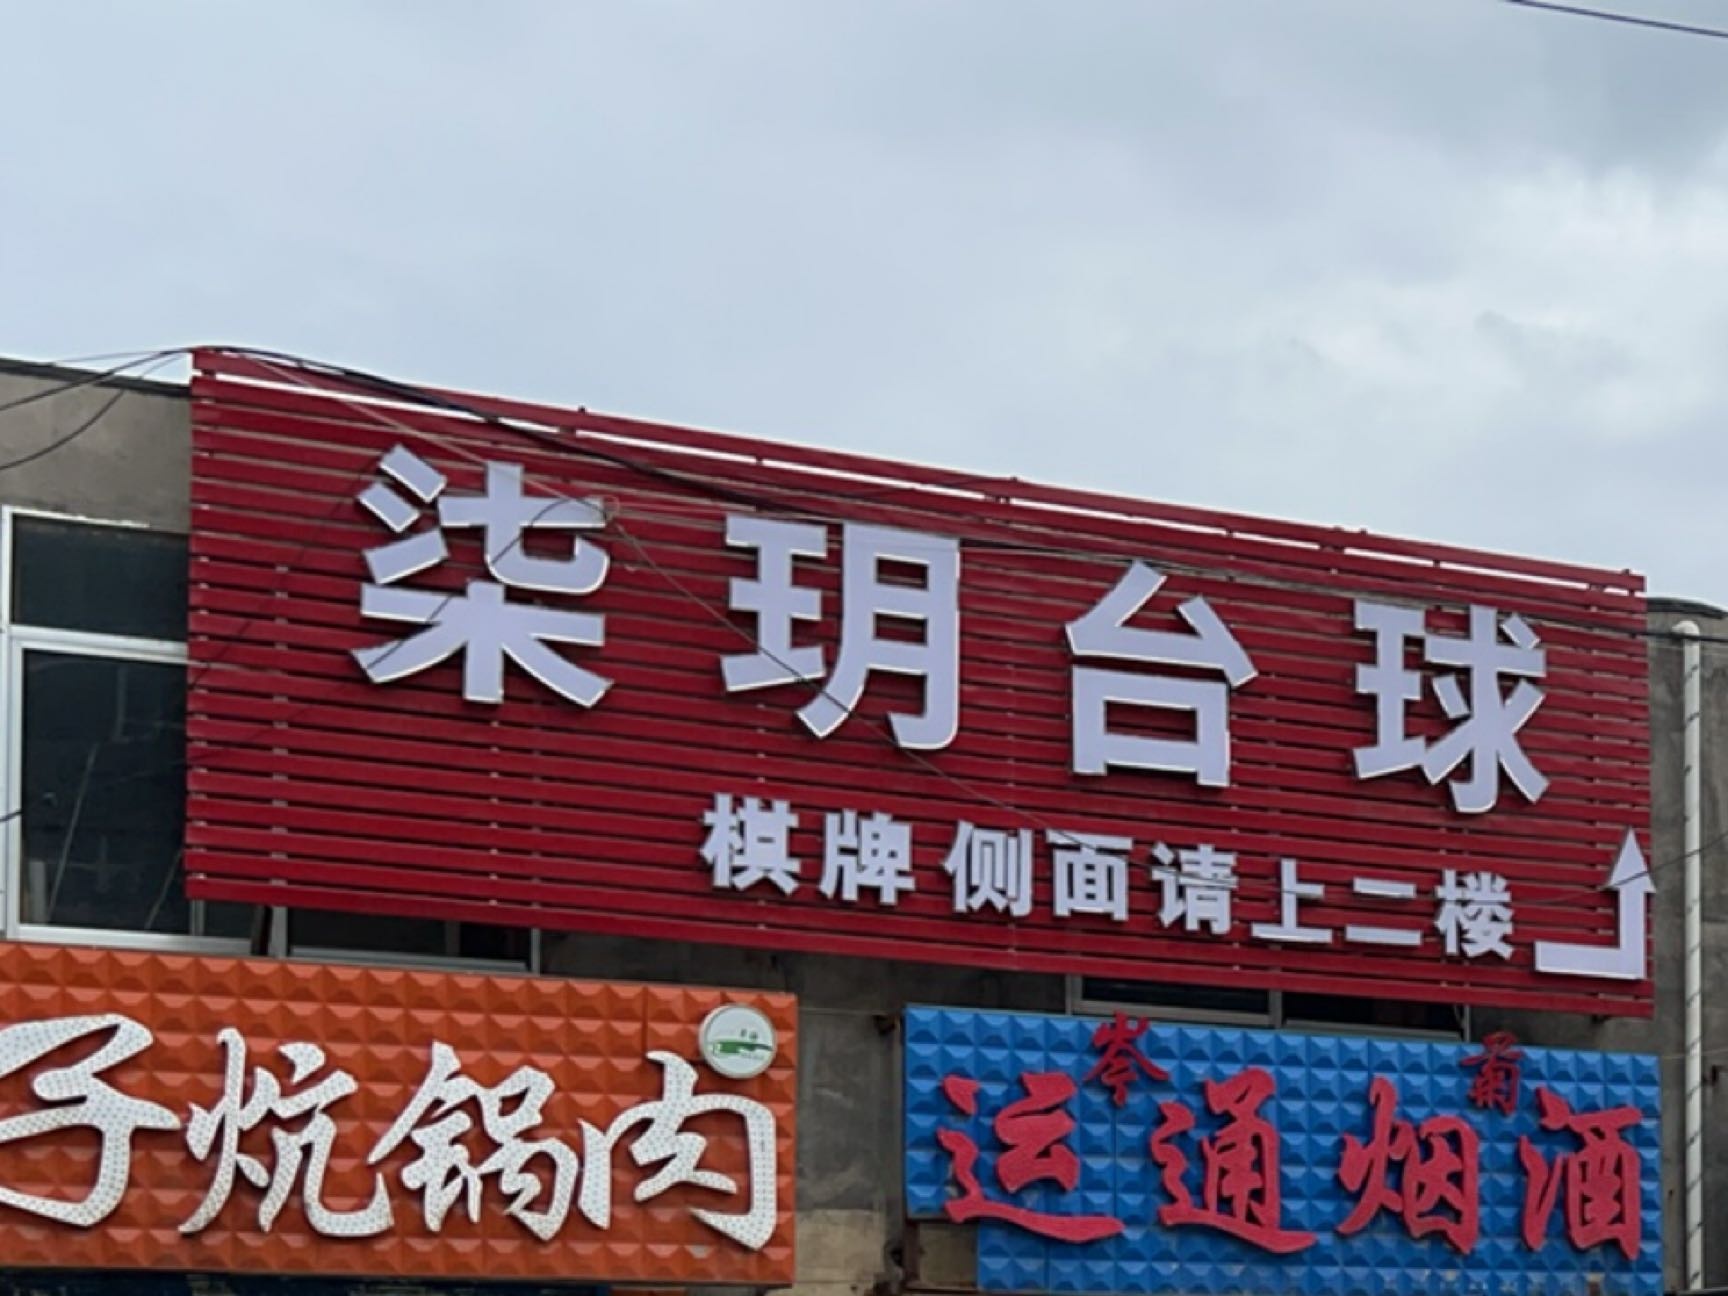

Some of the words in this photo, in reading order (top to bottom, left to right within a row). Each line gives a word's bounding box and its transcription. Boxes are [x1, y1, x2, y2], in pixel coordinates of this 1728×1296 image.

[350, 444, 1548, 813] 柒玥台球
[0, 1013, 777, 1251] 子炕锅肉
[936, 1067, 1643, 1261] 运通烟酒
